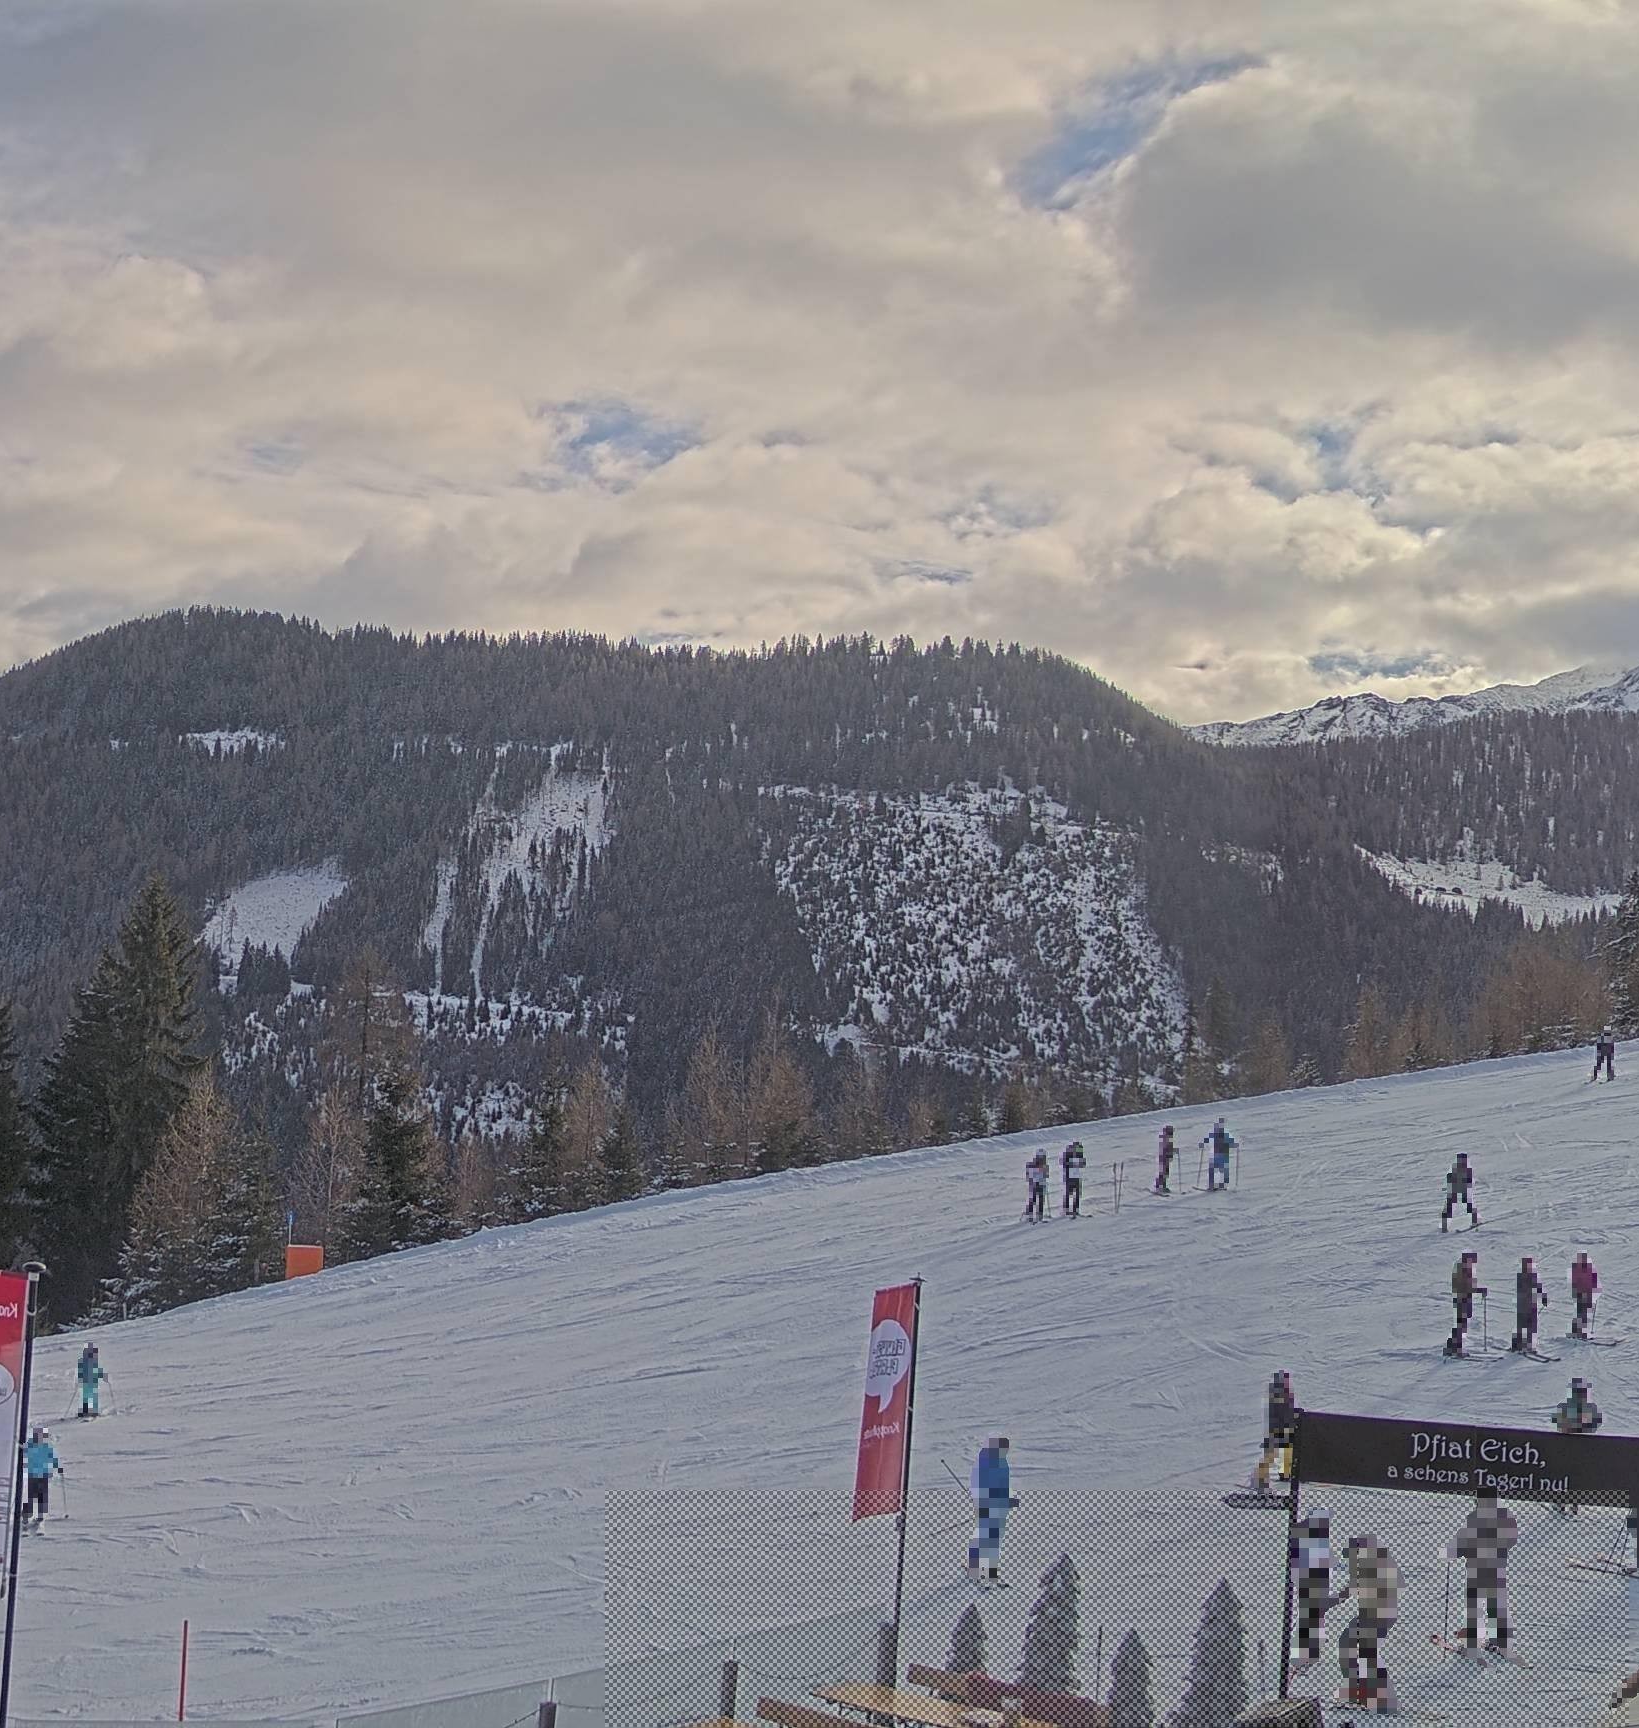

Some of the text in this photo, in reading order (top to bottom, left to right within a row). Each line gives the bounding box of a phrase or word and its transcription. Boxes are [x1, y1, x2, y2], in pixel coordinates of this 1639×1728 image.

[1410, 1432, 1547, 1468] Pfiat Eich,
[1387, 1465, 1398, 1478] a
[1404, 1464, 1470, 1484] schens
[1474, 1469, 1534, 1491] Tagerl
